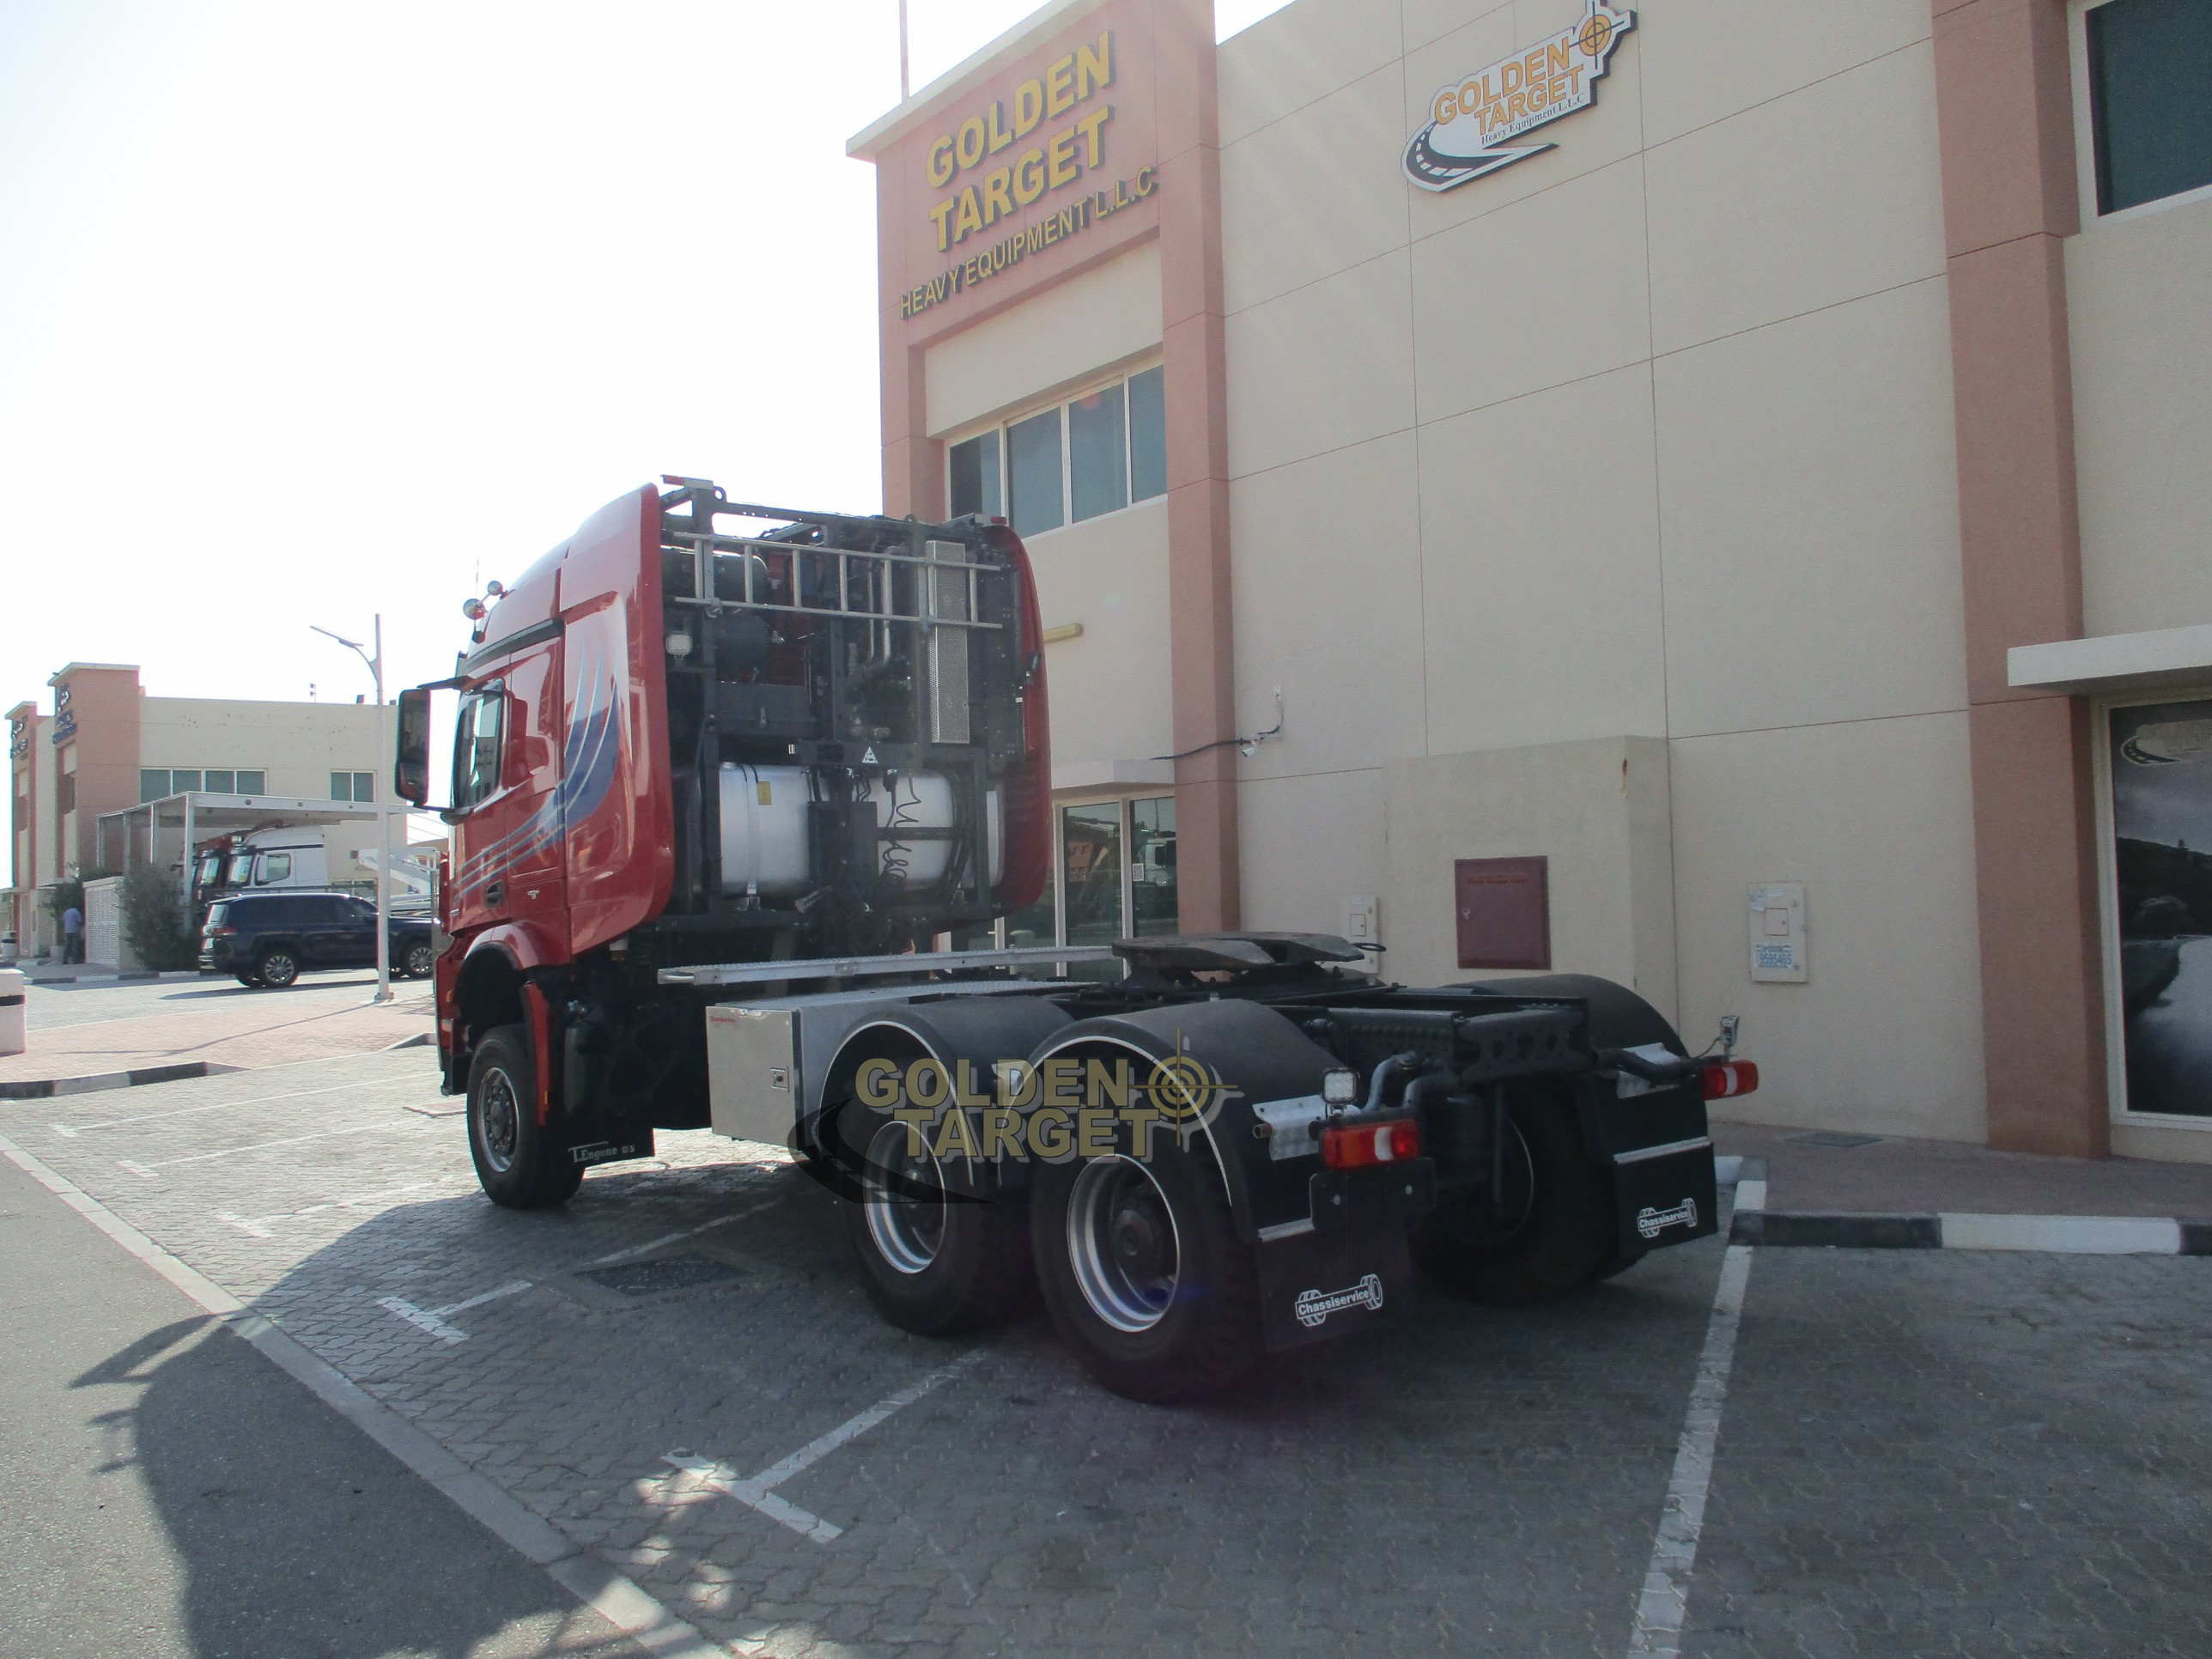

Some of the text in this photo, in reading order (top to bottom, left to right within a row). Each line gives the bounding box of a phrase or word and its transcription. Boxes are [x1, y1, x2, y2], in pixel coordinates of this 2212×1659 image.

[926, 30, 1112, 189] GOLDEN
[1435, 36, 1571, 125] GOLDEN
[1474, 64, 1584, 136] TARGET
[1481, 128, 1508, 145] Heavy
[1510, 106, 1556, 133] Equipment
[929, 106, 1110, 252] TARGET
[900, 264, 962, 319] HEAVY
[965, 196, 1090, 287] EQUIPMENT
[1297, 1289, 1370, 1316] Chassiservice
